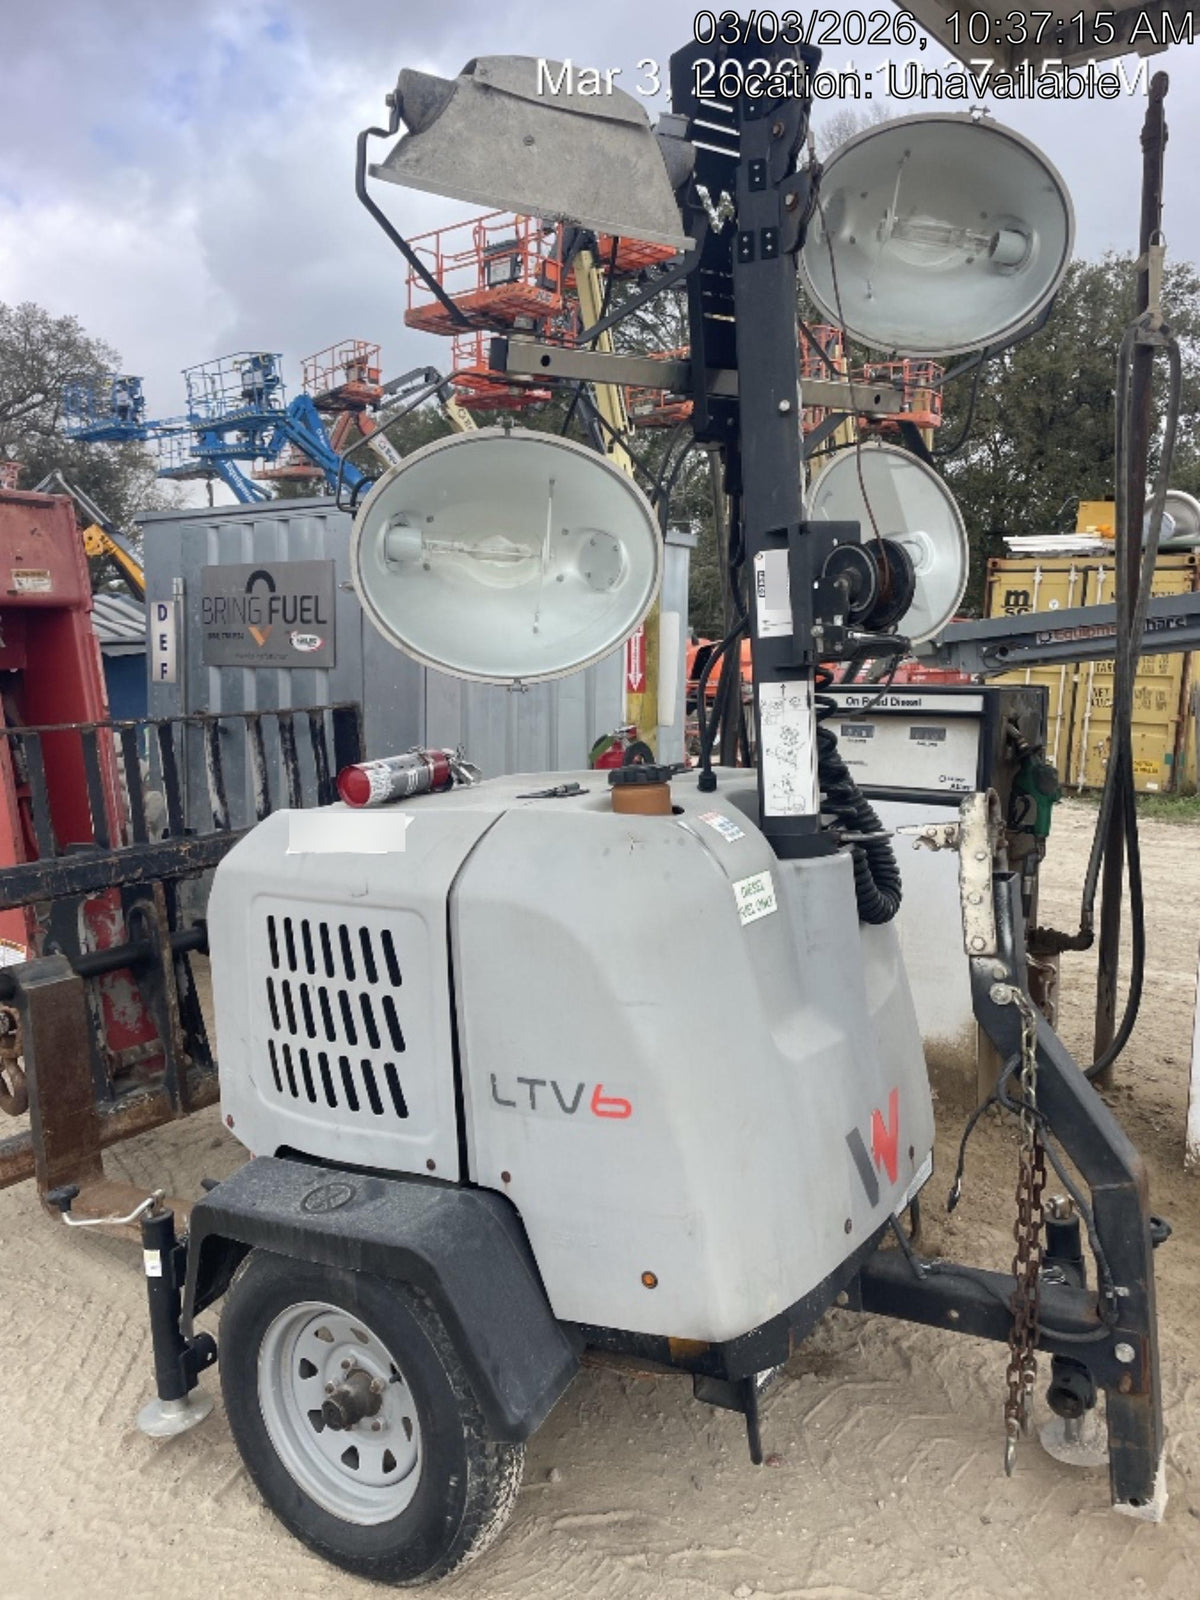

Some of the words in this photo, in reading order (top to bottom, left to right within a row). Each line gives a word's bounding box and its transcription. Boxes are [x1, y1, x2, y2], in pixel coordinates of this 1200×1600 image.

[202, 596, 261, 626] BRING
[268, 594, 328, 625] FUEL
[846, 696, 859, 707] On
[489, 1072, 633, 1120] LTV6
